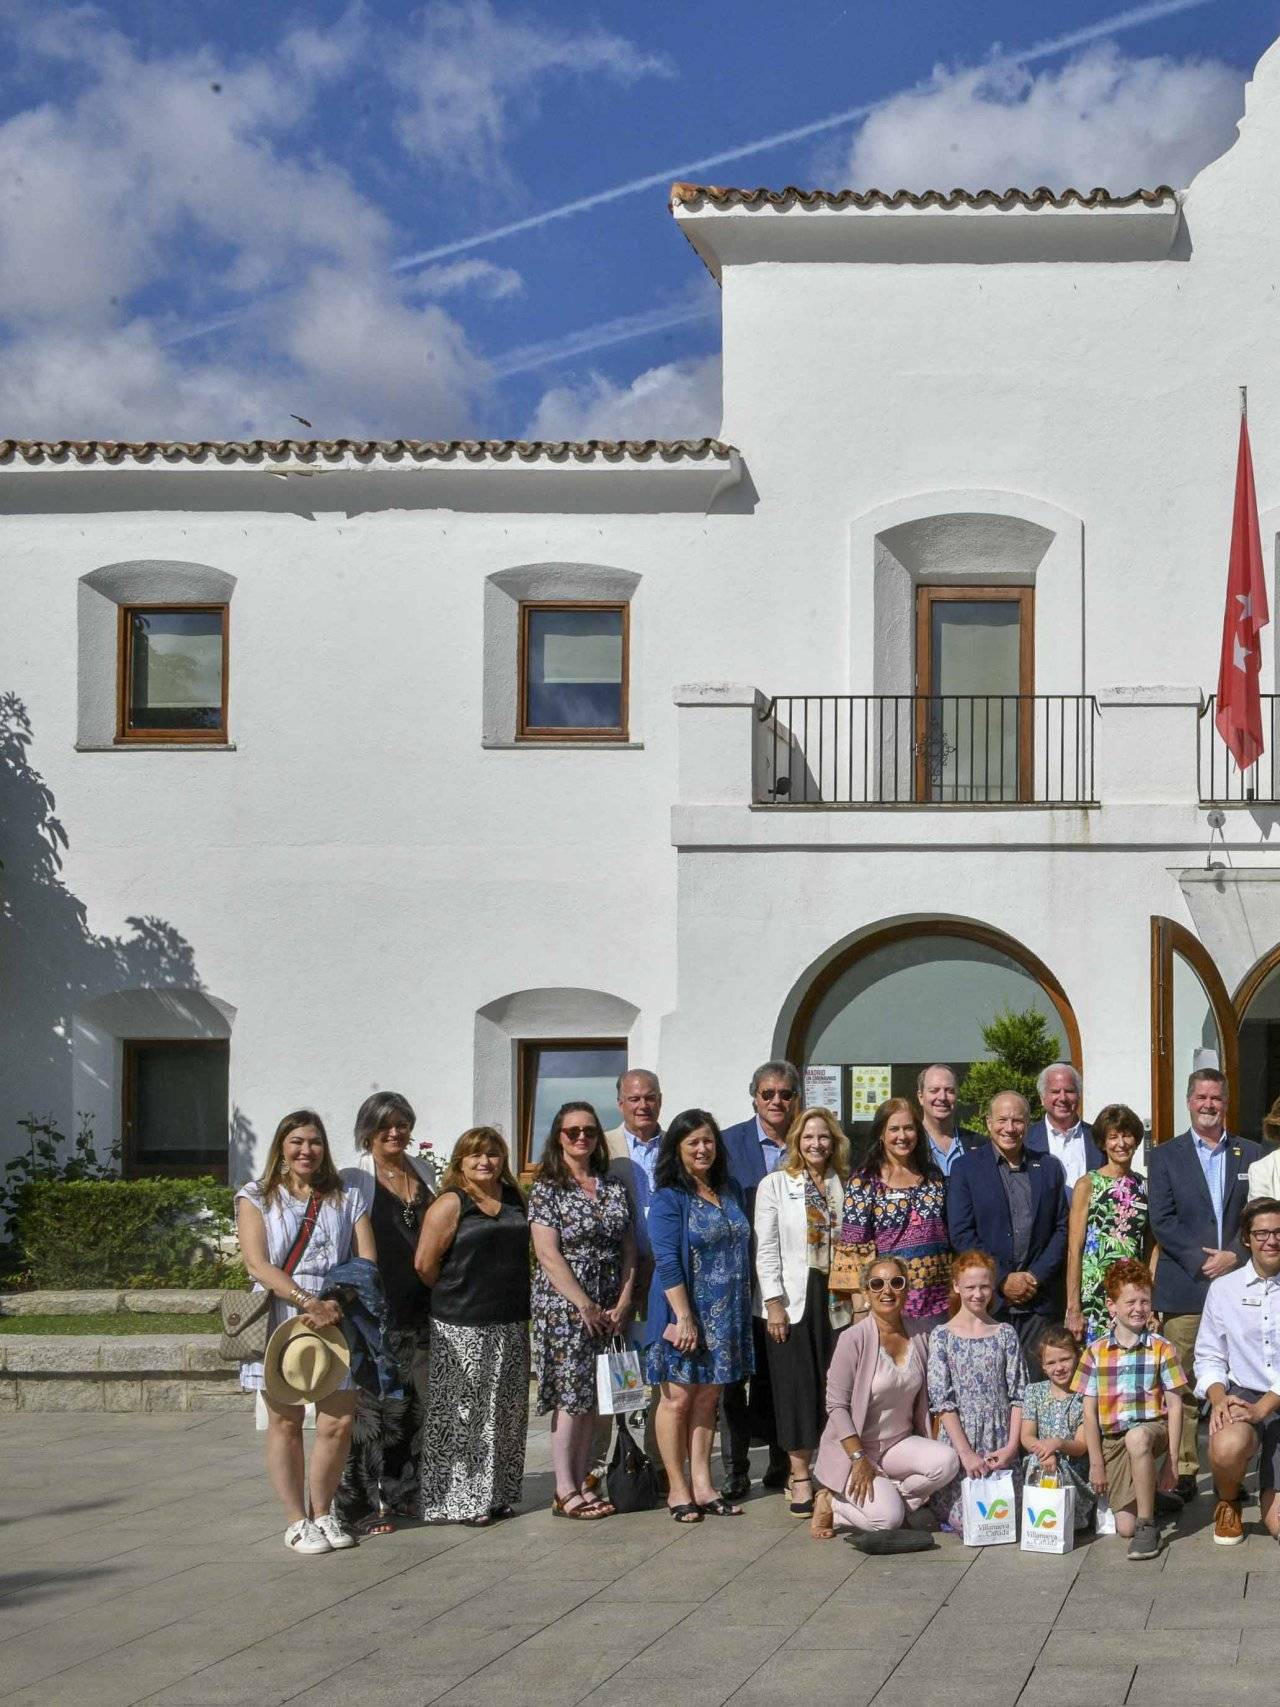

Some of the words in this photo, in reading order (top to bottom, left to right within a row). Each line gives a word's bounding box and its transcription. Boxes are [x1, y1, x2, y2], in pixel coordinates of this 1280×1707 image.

[978, 1523, 1010, 1532] Villanueva
[985, 1530, 1010, 1538] Cañada
[1026, 1530, 1058, 1540] Villanueva
